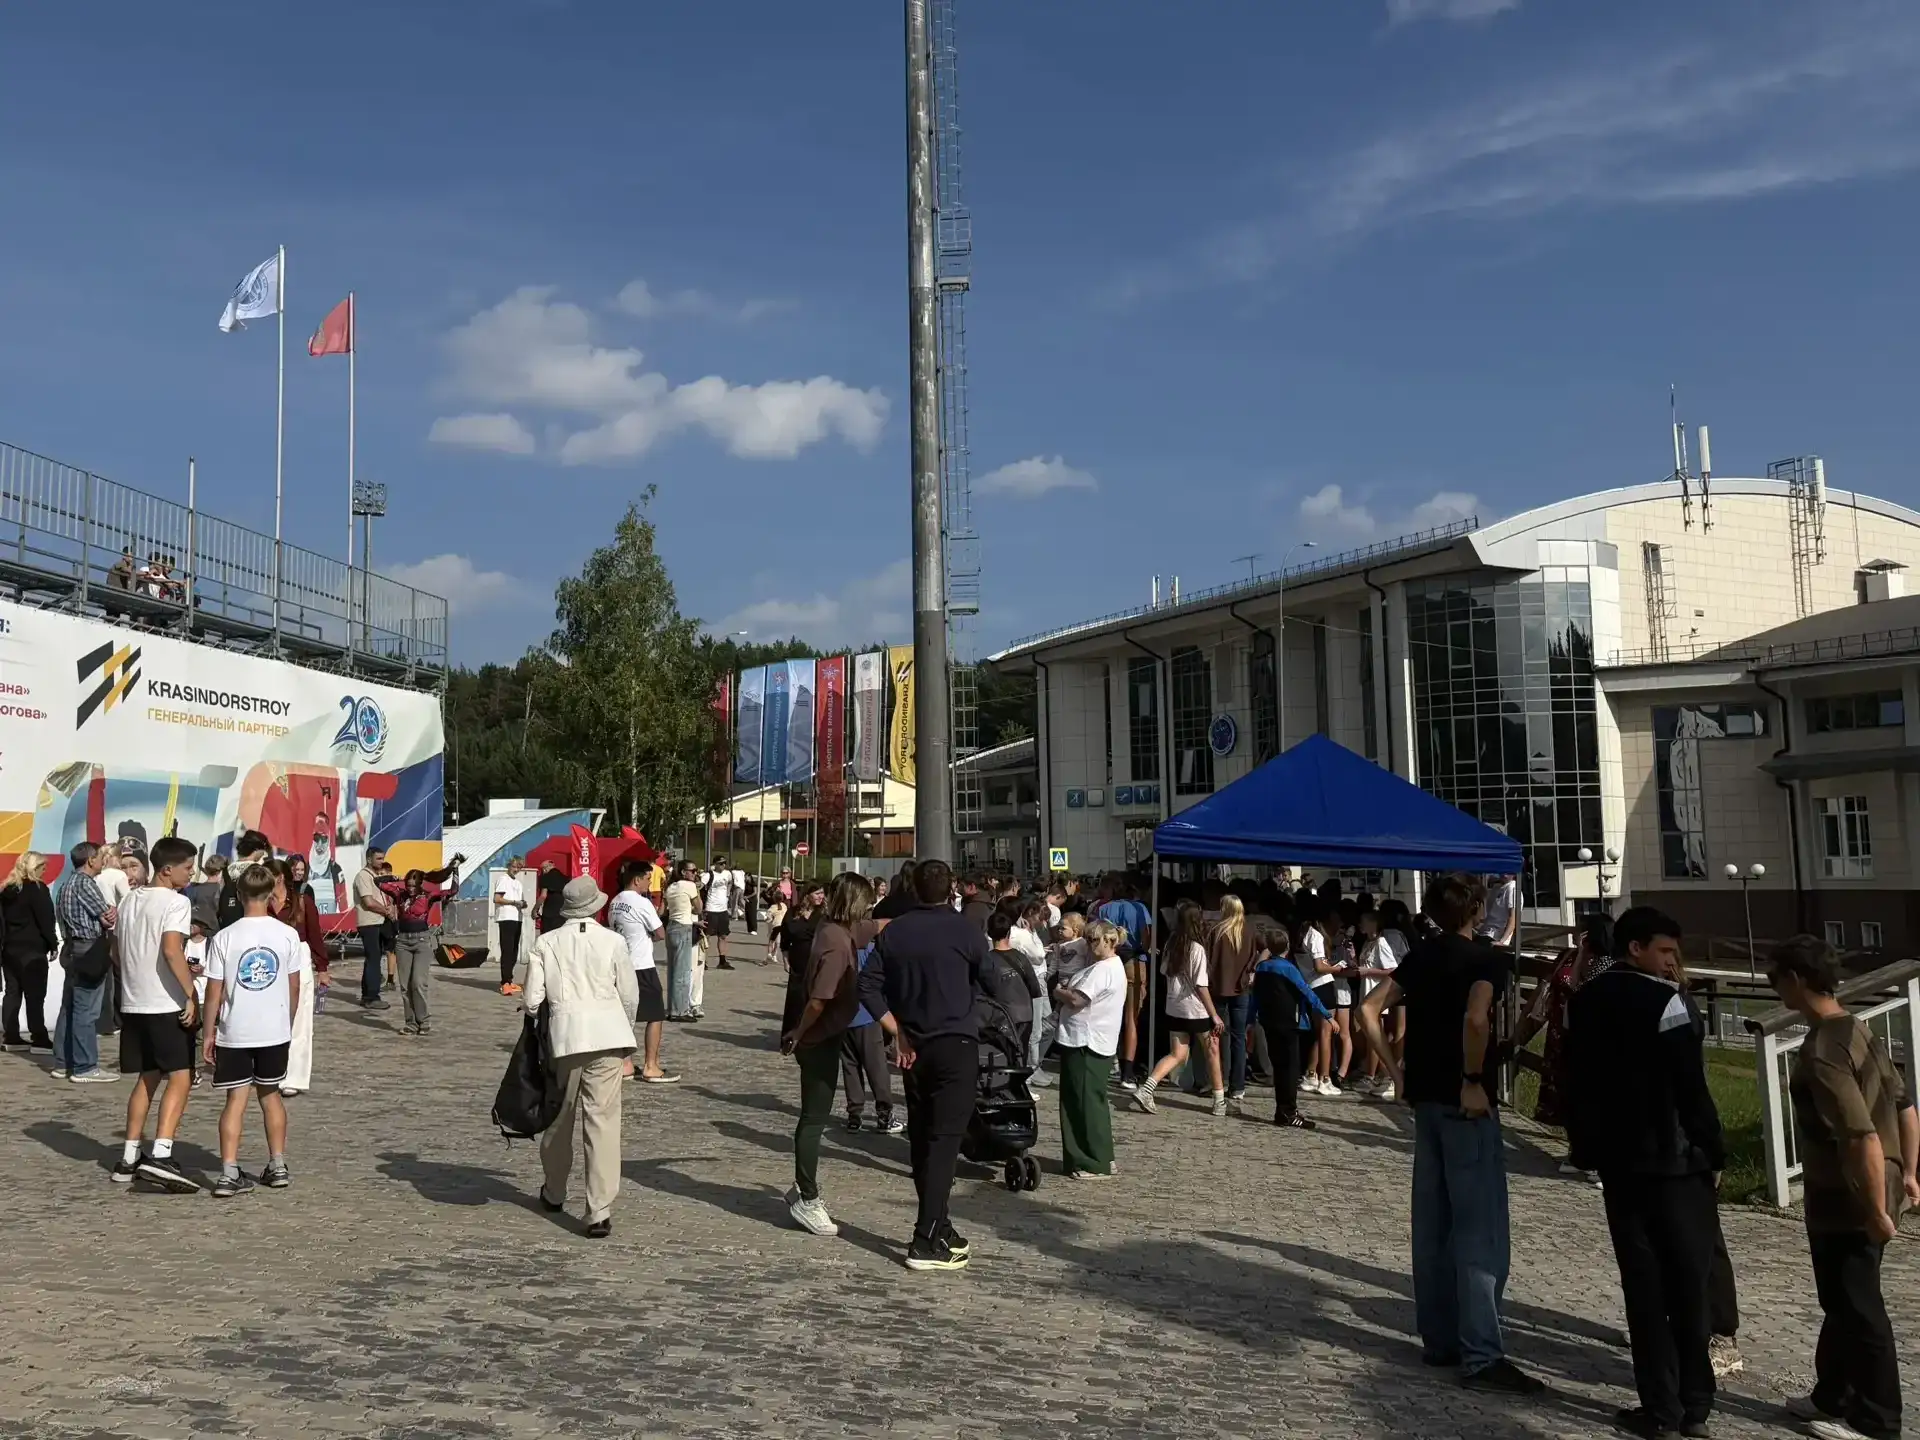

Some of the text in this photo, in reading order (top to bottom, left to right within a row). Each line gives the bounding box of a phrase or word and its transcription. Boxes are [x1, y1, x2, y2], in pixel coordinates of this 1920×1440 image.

[148, 680, 290, 716] KRASINDORSTROY
[148, 708, 289, 737] ГЕНЕРАЛЬНЫЙ ПАРТНЕР
